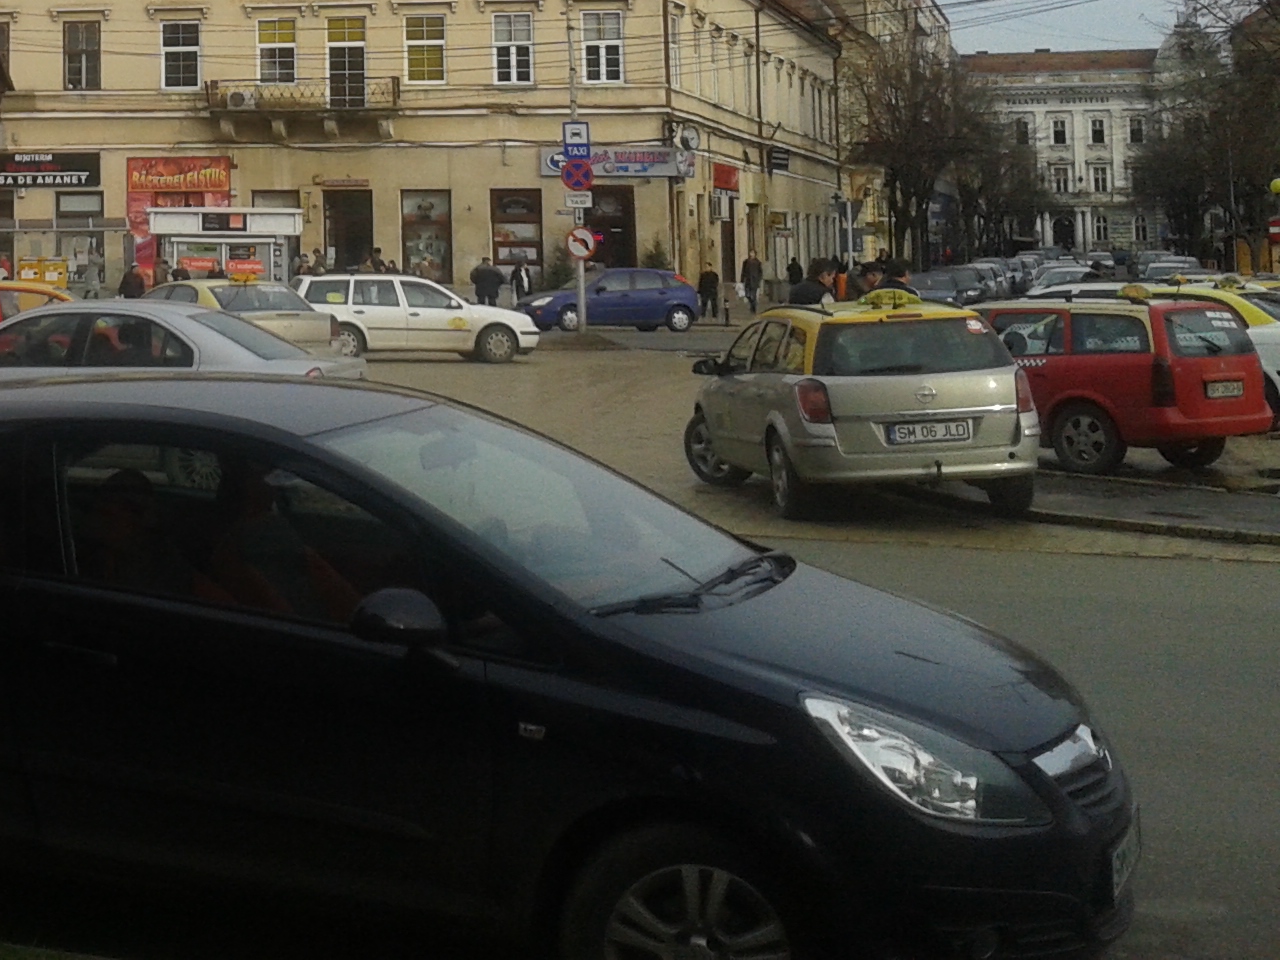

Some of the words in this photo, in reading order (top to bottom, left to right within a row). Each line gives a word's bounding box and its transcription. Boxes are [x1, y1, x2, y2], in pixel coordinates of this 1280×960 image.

[568, 146, 588, 156] TAXI
[0, 176, 13, 185] SA
[18, 176, 33, 184] DE
[37, 175, 88, 184] AMANET
[897, 426, 917, 439] SM
[921, 425, 937, 438] 06
[943, 423, 966, 437] JLD
